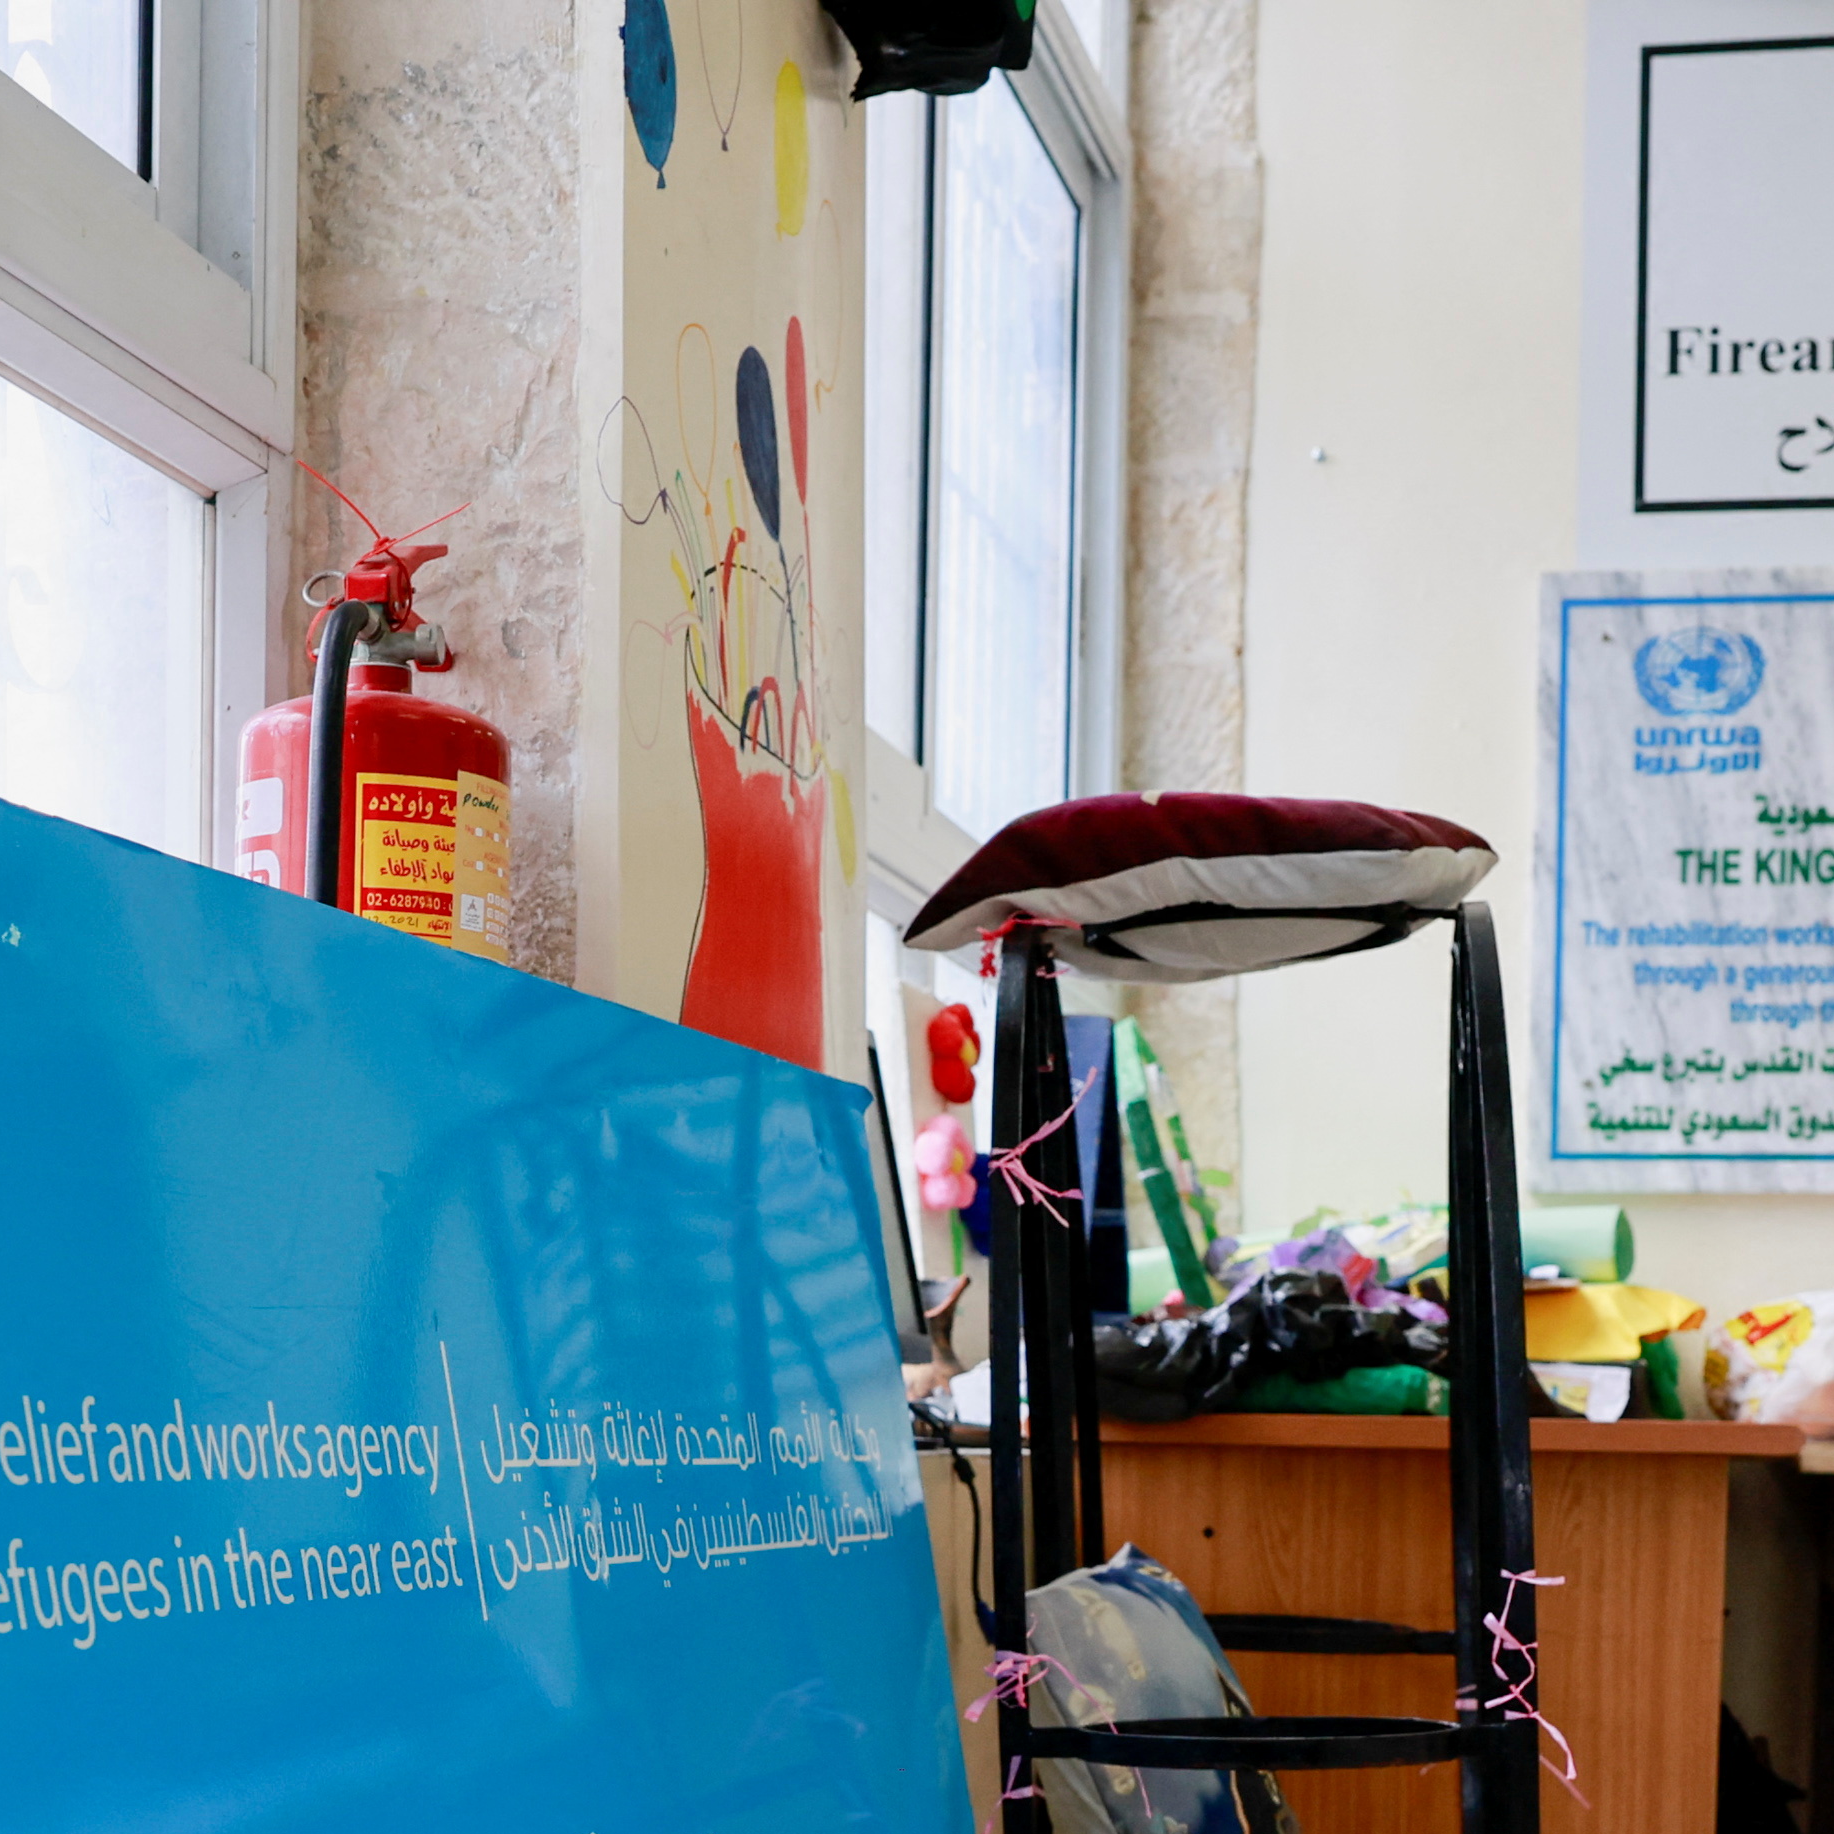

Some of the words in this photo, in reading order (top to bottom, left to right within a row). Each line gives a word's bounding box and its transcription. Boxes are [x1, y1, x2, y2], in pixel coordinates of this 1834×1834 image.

[1634, 726, 1762, 747] unrwa
[382, 829, 429, 853] وصيانة
[1675, 848, 1741, 885] THE
[1582, 920, 1621, 947] The
[1627, 920, 1769, 947] rehabilitation
[1633, 960, 1718, 993] through
[1729, 997, 1816, 1030] through
[1600, 1048, 1656, 1087] سخي
[1732, 1046, 1815, 1081] القدس
[1587, 1102, 1675, 1142] للتنمية
[1680, 1107, 1780, 1145] السعودي
[105, 1397, 191, 1484] and
[191, 1400, 308, 1482] works
[315, 1418, 441, 1496] agency
[480, 1399, 598, 1484] وتشغيل
[602, 1400, 667, 1484] لإغاثة
[675, 1412, 763, 1472] المتحدة
[769, 1400, 825, 1476] الأمم
[829, 1408, 882, 1472] وكالة
[488, 1491, 579, 1591] الأدنى
[578, 1497, 650, 1583] الشرق
[650, 1503, 690, 1588] في
[690, 1492, 827, 1570] الفلسطينيين
[173, 1535, 221, 1616] in
[222, 1527, 296, 1609] the
[298, 1541, 383, 1602] near
[390, 1534, 464, 1595] east
